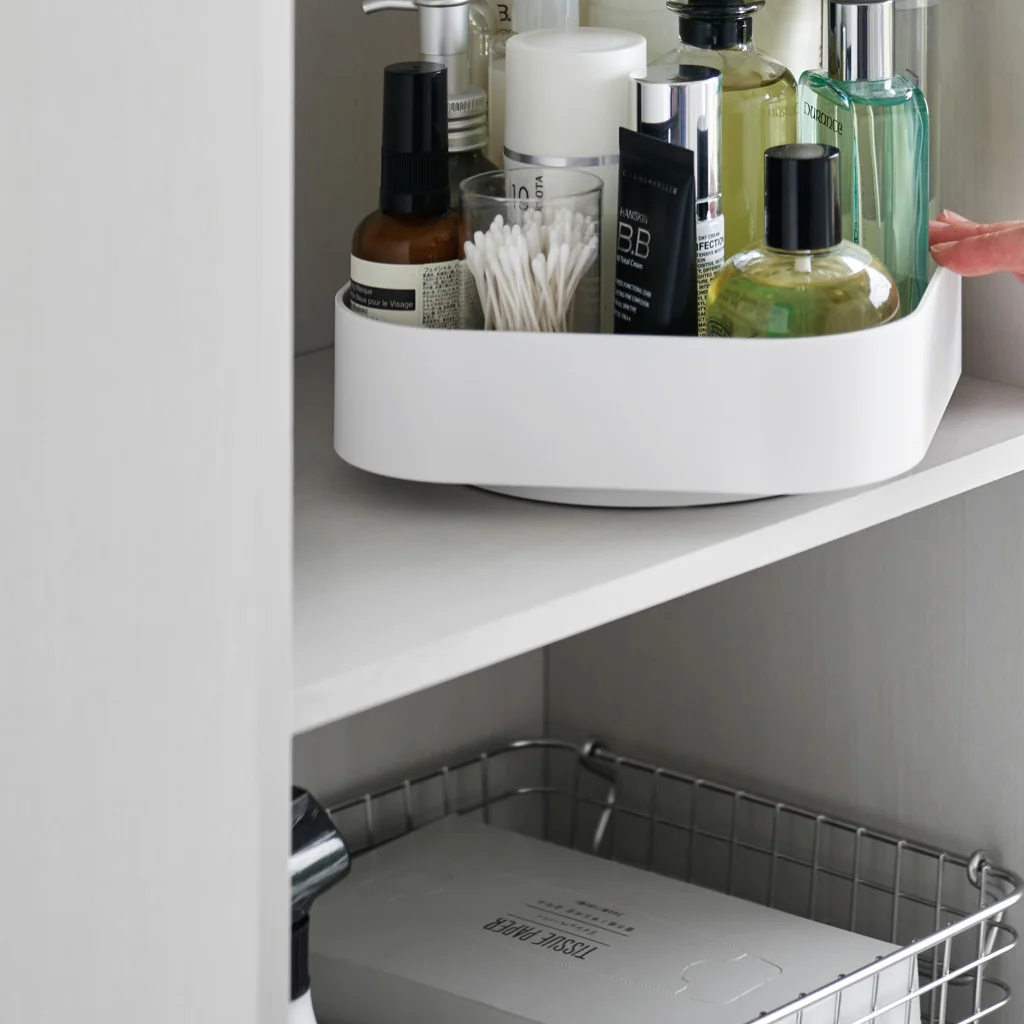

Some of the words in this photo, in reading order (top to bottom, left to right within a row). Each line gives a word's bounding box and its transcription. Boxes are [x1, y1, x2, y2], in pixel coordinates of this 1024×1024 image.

[617, 221, 651, 260] B.B
[367, 298, 381, 307] pour
[381, 299, 388, 307] le
[389, 300, 414, 310] Visage
[482, 916, 542, 942] PAPER
[531, 932, 598, 960] TISSUE
